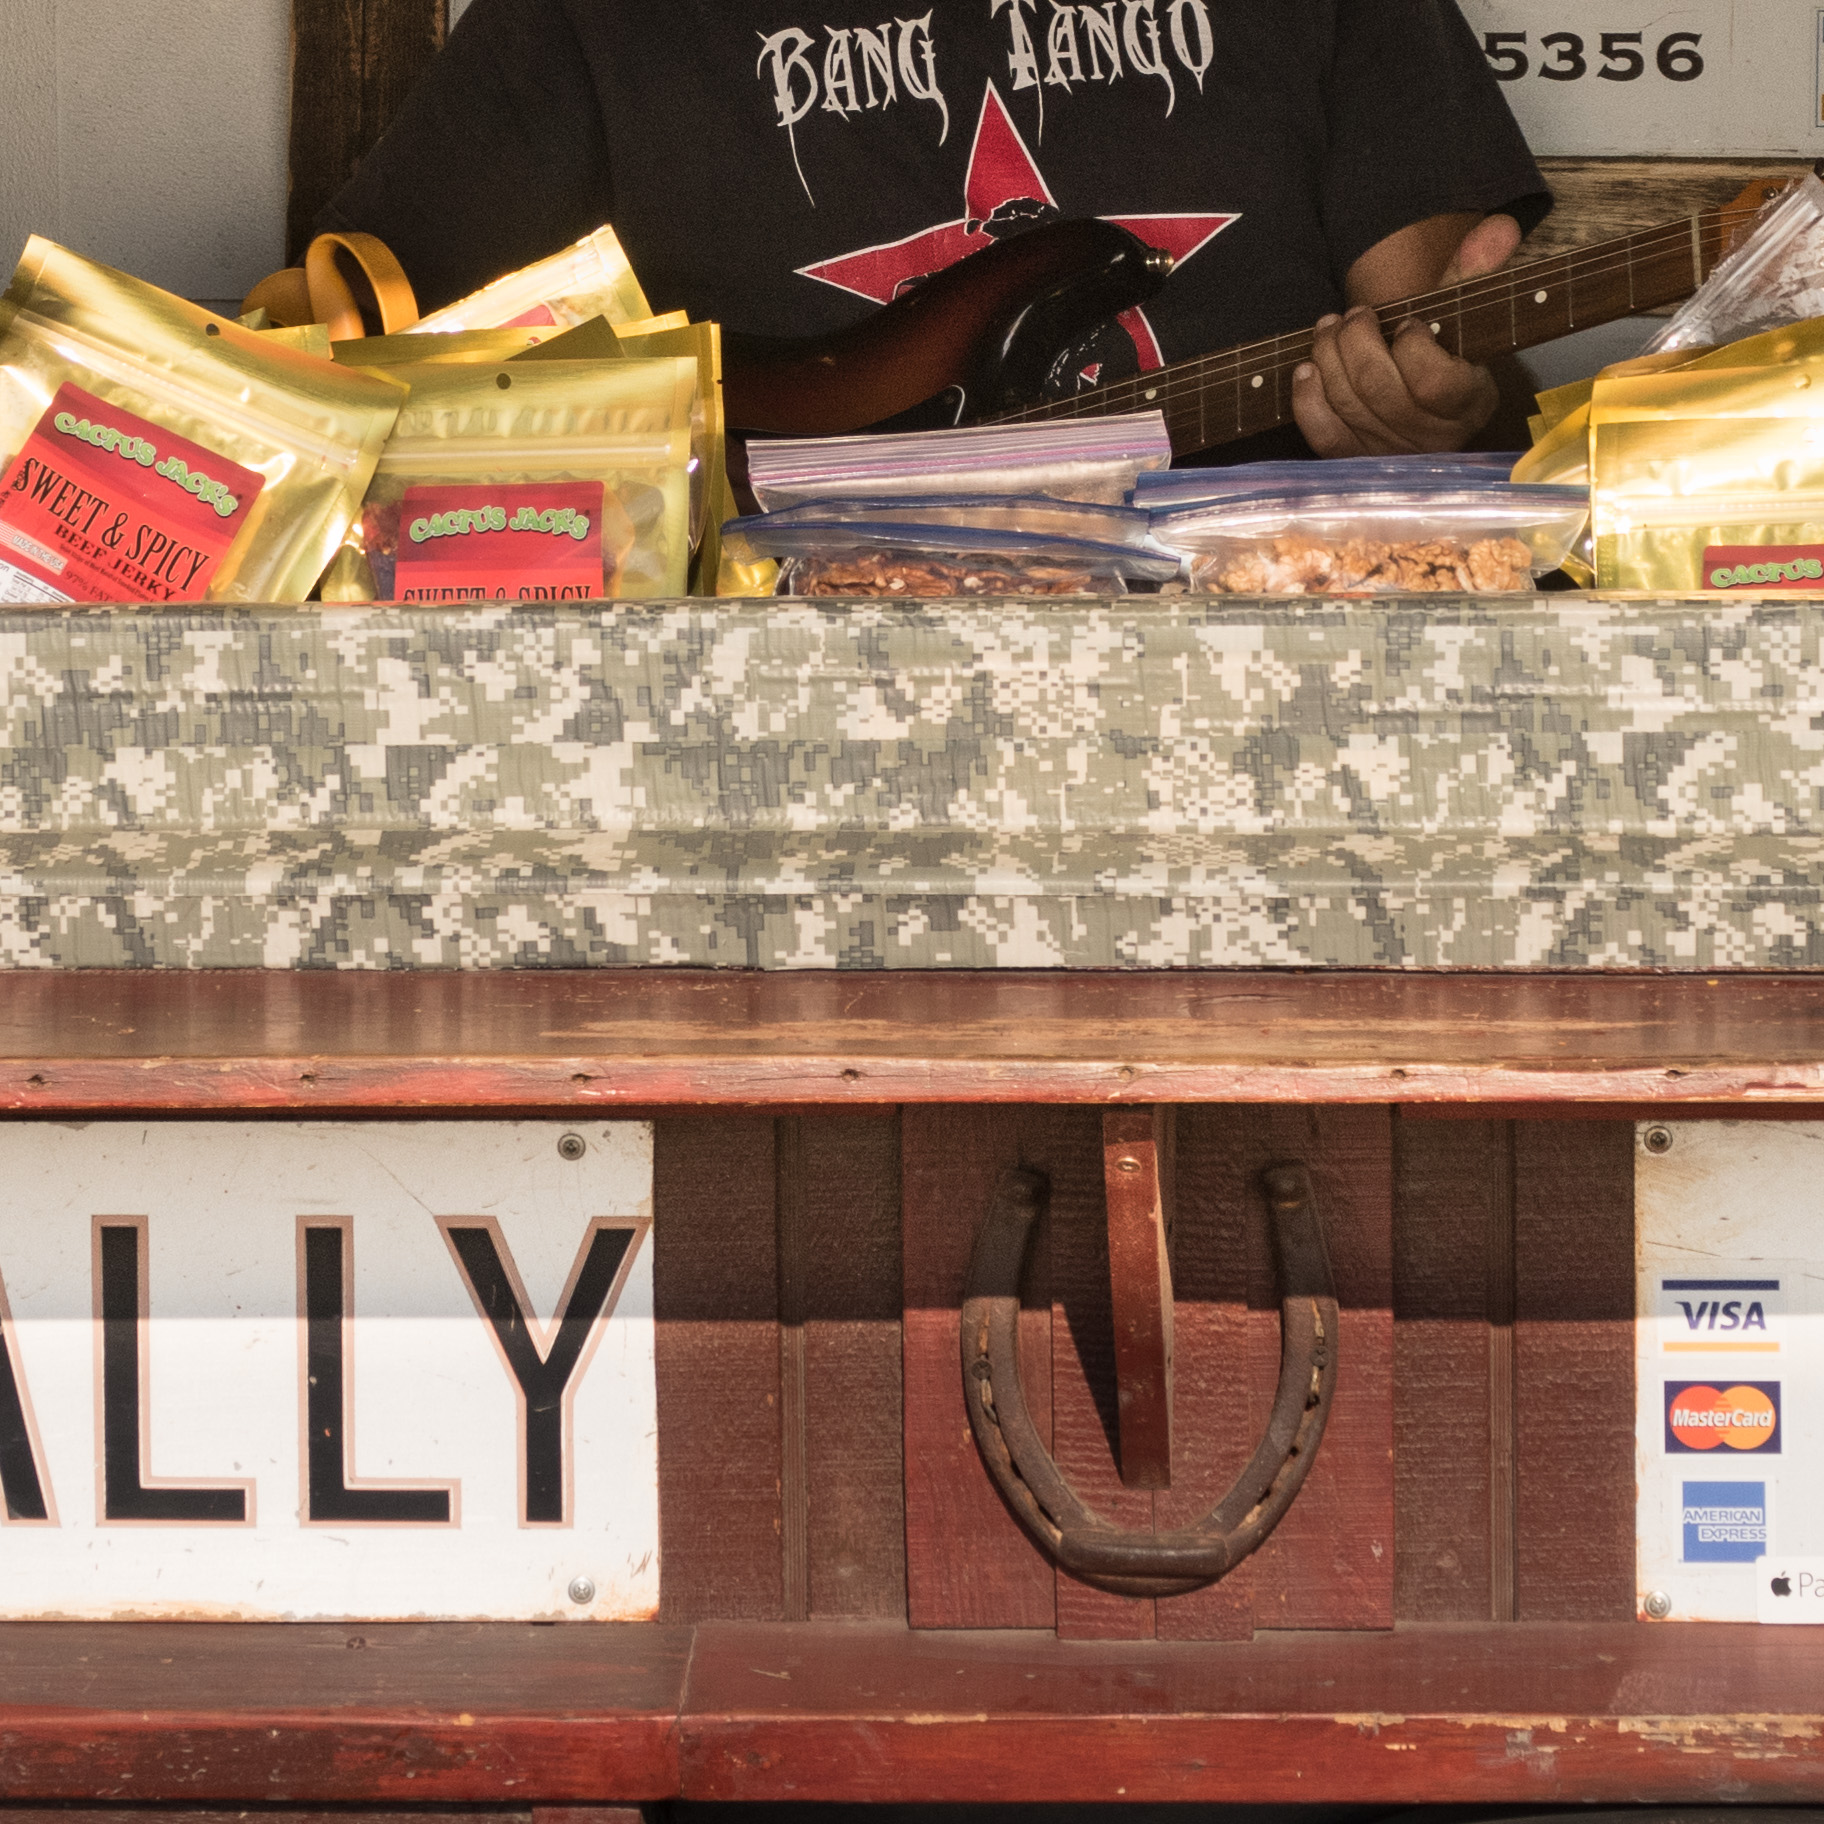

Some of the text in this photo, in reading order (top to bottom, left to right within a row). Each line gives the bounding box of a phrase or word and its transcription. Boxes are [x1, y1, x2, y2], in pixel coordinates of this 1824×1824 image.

[755, 8, 950, 207] BANG
[53, 412, 239, 518] CACTUS JACK'S
[17, 457, 211, 593] SWEET & SPICY
[409, 505, 590, 543] CACTUS JACK'S
[54, 524, 177, 601] BEEF JERKY
[1710, 558, 1824, 588] CACTUS
[1674, 1300, 1768, 1330] VISA
[1672, 1408, 1773, 1428] MasterCard
[1683, 1509, 1762, 1523] AMERICAN
[1700, 1527, 1767, 1541] EXPRESS
